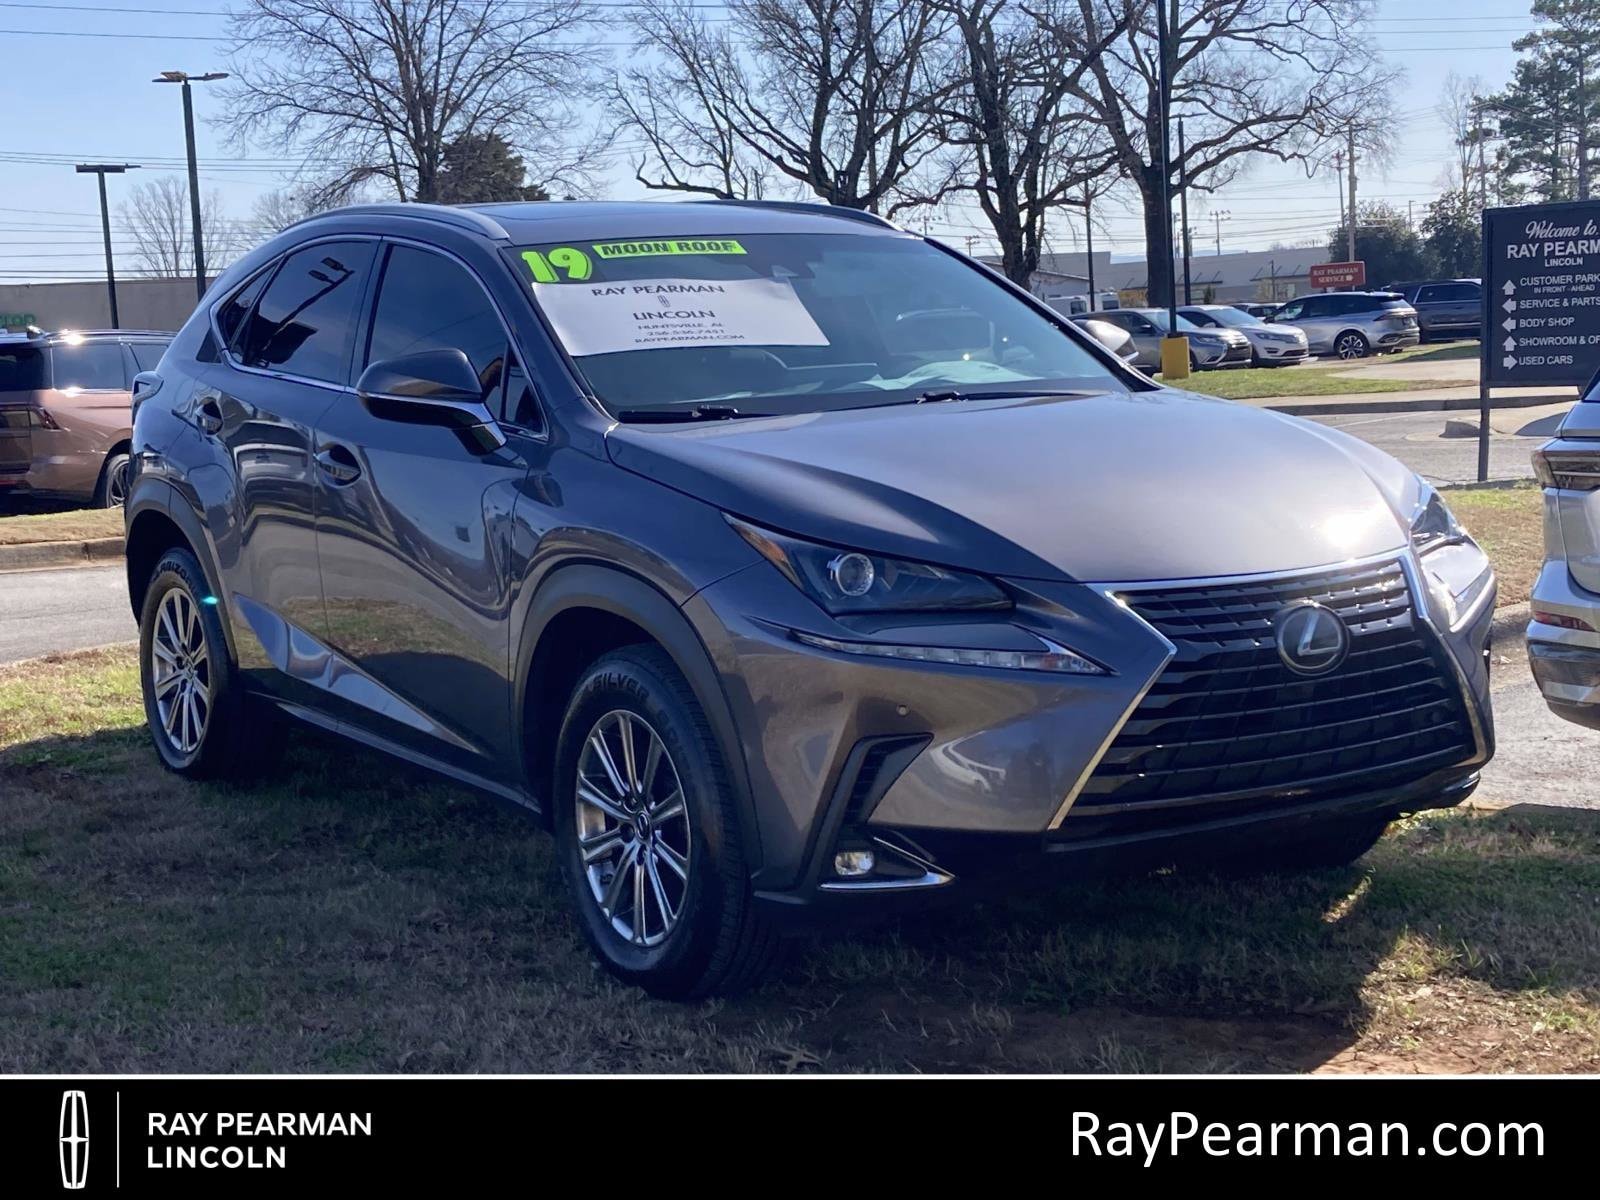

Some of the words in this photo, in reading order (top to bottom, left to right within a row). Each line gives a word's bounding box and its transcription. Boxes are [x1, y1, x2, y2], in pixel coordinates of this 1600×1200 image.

[1525, 220, 1580, 239] Welcome
[600, 241, 669, 256] MOON
[676, 240, 735, 253] ROOF
[1507, 243, 1540, 259] RAY
[1543, 239, 1600, 256] PEARM
[521, 247, 593, 283] 19
[1544, 257, 1584, 268] LINCOLN
[1318, 275, 1345, 283] SERVICE
[1520, 275, 1573, 286] CUSTOMER
[1575, 273, 1600, 284] PARK
[592, 286, 626, 296] RAY
[633, 284, 725, 295] PEARMAN
[1542, 286, 1566, 294] FRONT
[1571, 284, 1595, 292] AHEAD
[1519, 299, 1560, 309] SERVICE
[1562, 298, 1569, 307] &
[1571, 296, 1600, 306] PARTS
[633, 310, 716, 321] LINCOLN
[1519, 318, 1546, 328] BODY
[1548, 317, 1575, 327] SHOP
[634, 334, 745, 343] RAYPEARMAN.COM
[1519, 336, 1577, 346] SHOWROOM
[1579, 336, 1586, 345] &
[1519, 356, 1545, 365] USED
[1547, 355, 1574, 365] CARS
